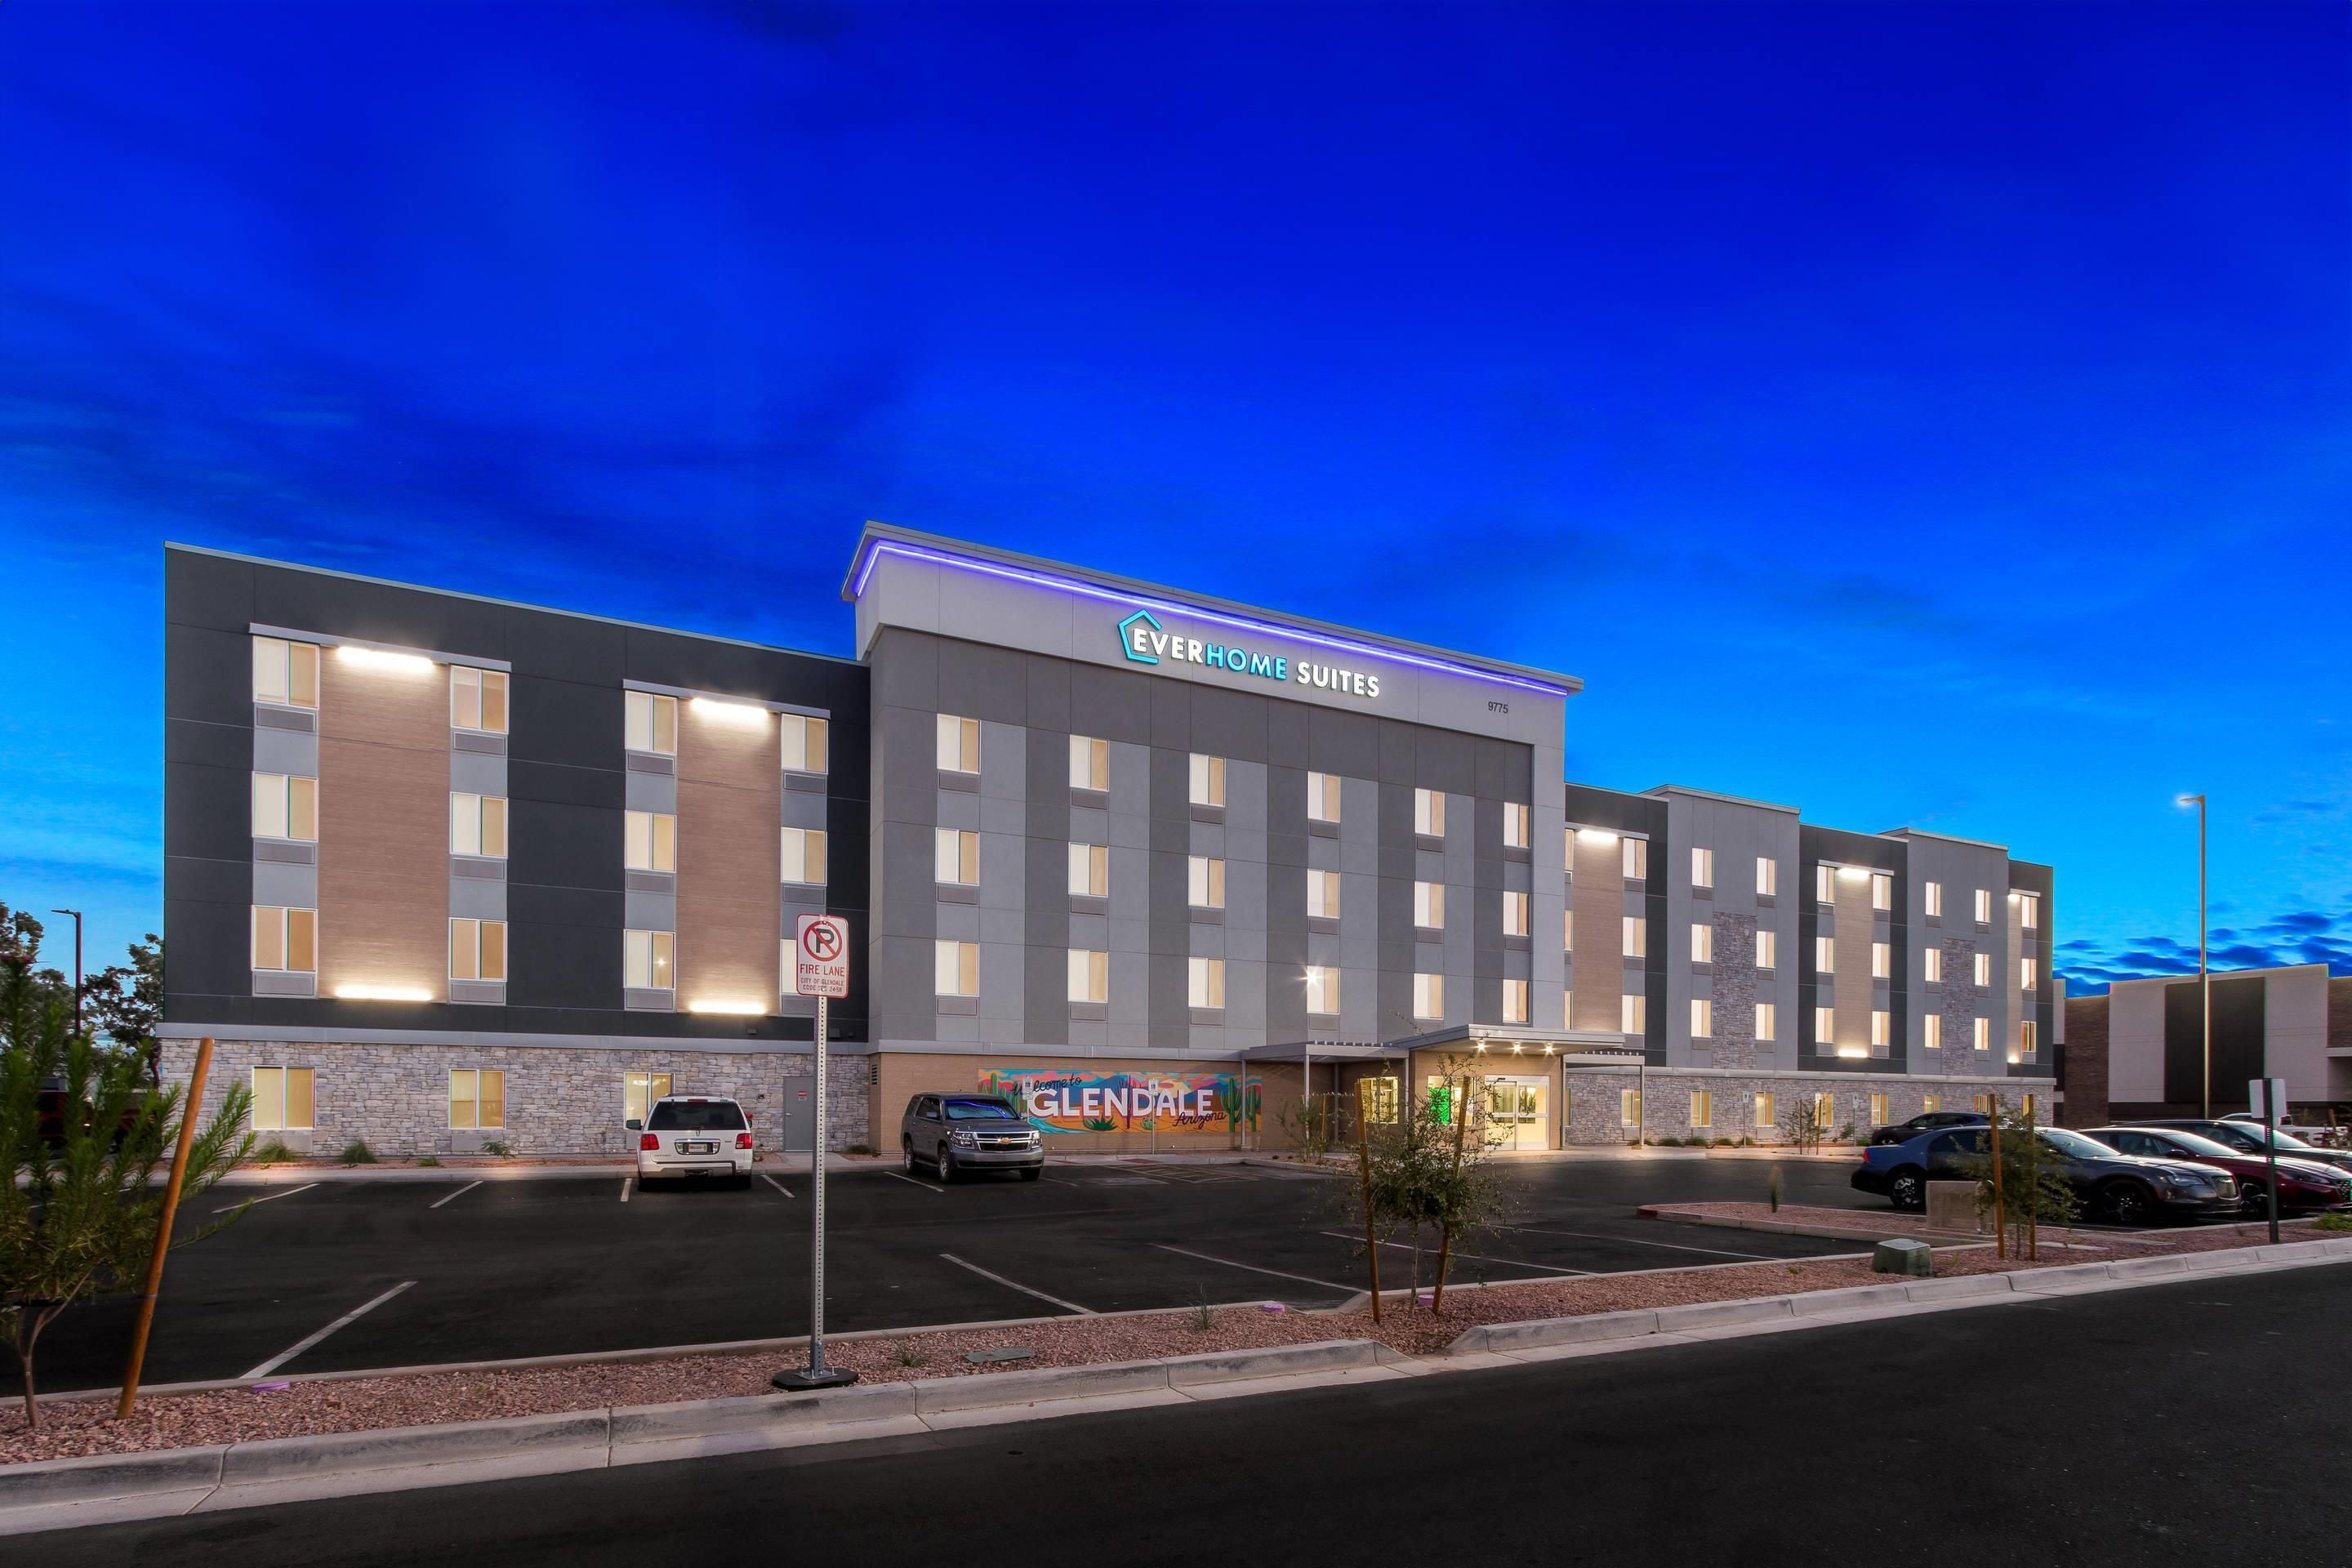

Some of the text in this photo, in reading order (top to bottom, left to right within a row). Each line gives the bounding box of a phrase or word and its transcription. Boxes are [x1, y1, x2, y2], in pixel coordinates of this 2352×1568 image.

[1134, 627, 1380, 697] EVERHOME SUITES
[1488, 701, 1508, 714] 9775
[800, 964, 845, 977] FIRE LANE
[1028, 1087, 1214, 1118] GLENDALE
[1172, 1111, 1227, 1129] Arizona
